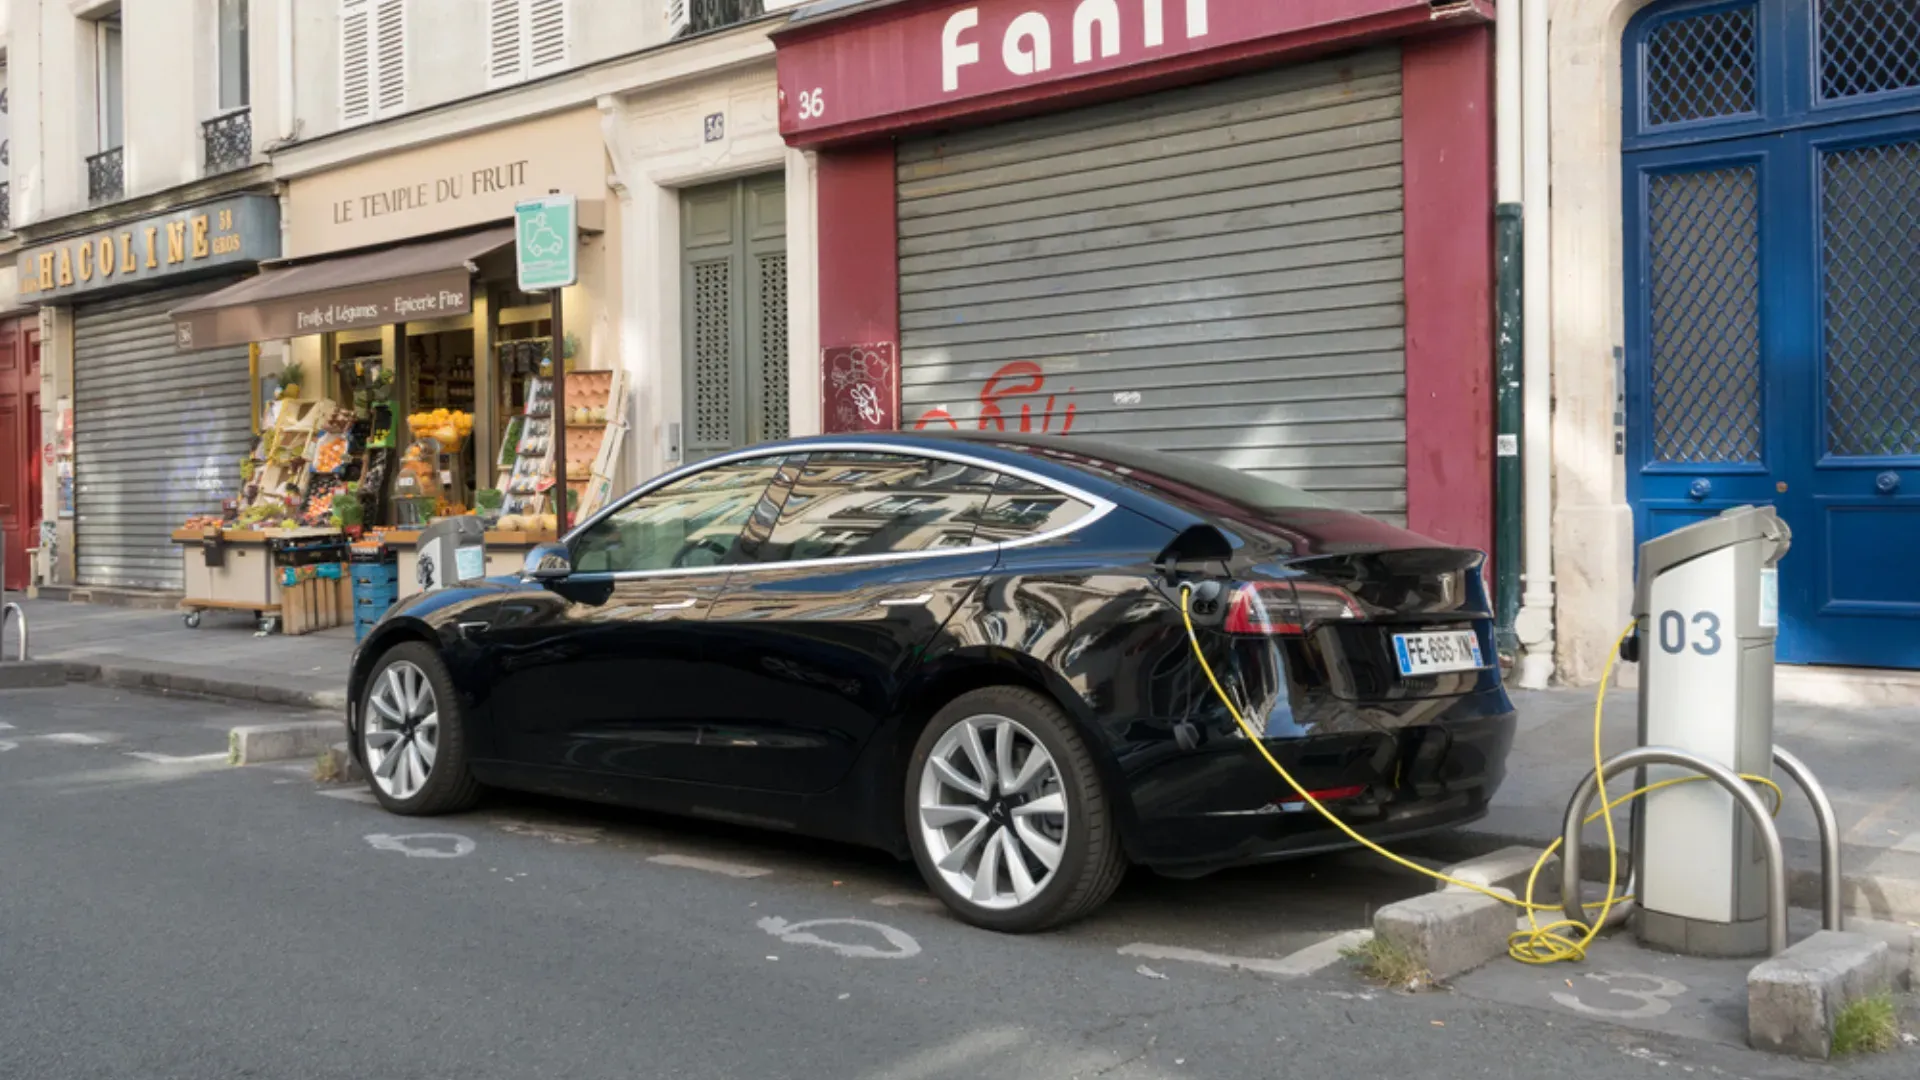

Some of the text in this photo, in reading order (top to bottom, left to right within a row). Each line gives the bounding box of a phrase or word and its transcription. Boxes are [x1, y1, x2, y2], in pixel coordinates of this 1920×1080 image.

[798, 87, 824, 120] 36
[334, 160, 528, 224] LE TEMPLE DU FRUIT
[39, 214, 209, 291] HACOLINE
[439, 290, 464, 310] Fine
[1659, 609, 1722, 656] 03
